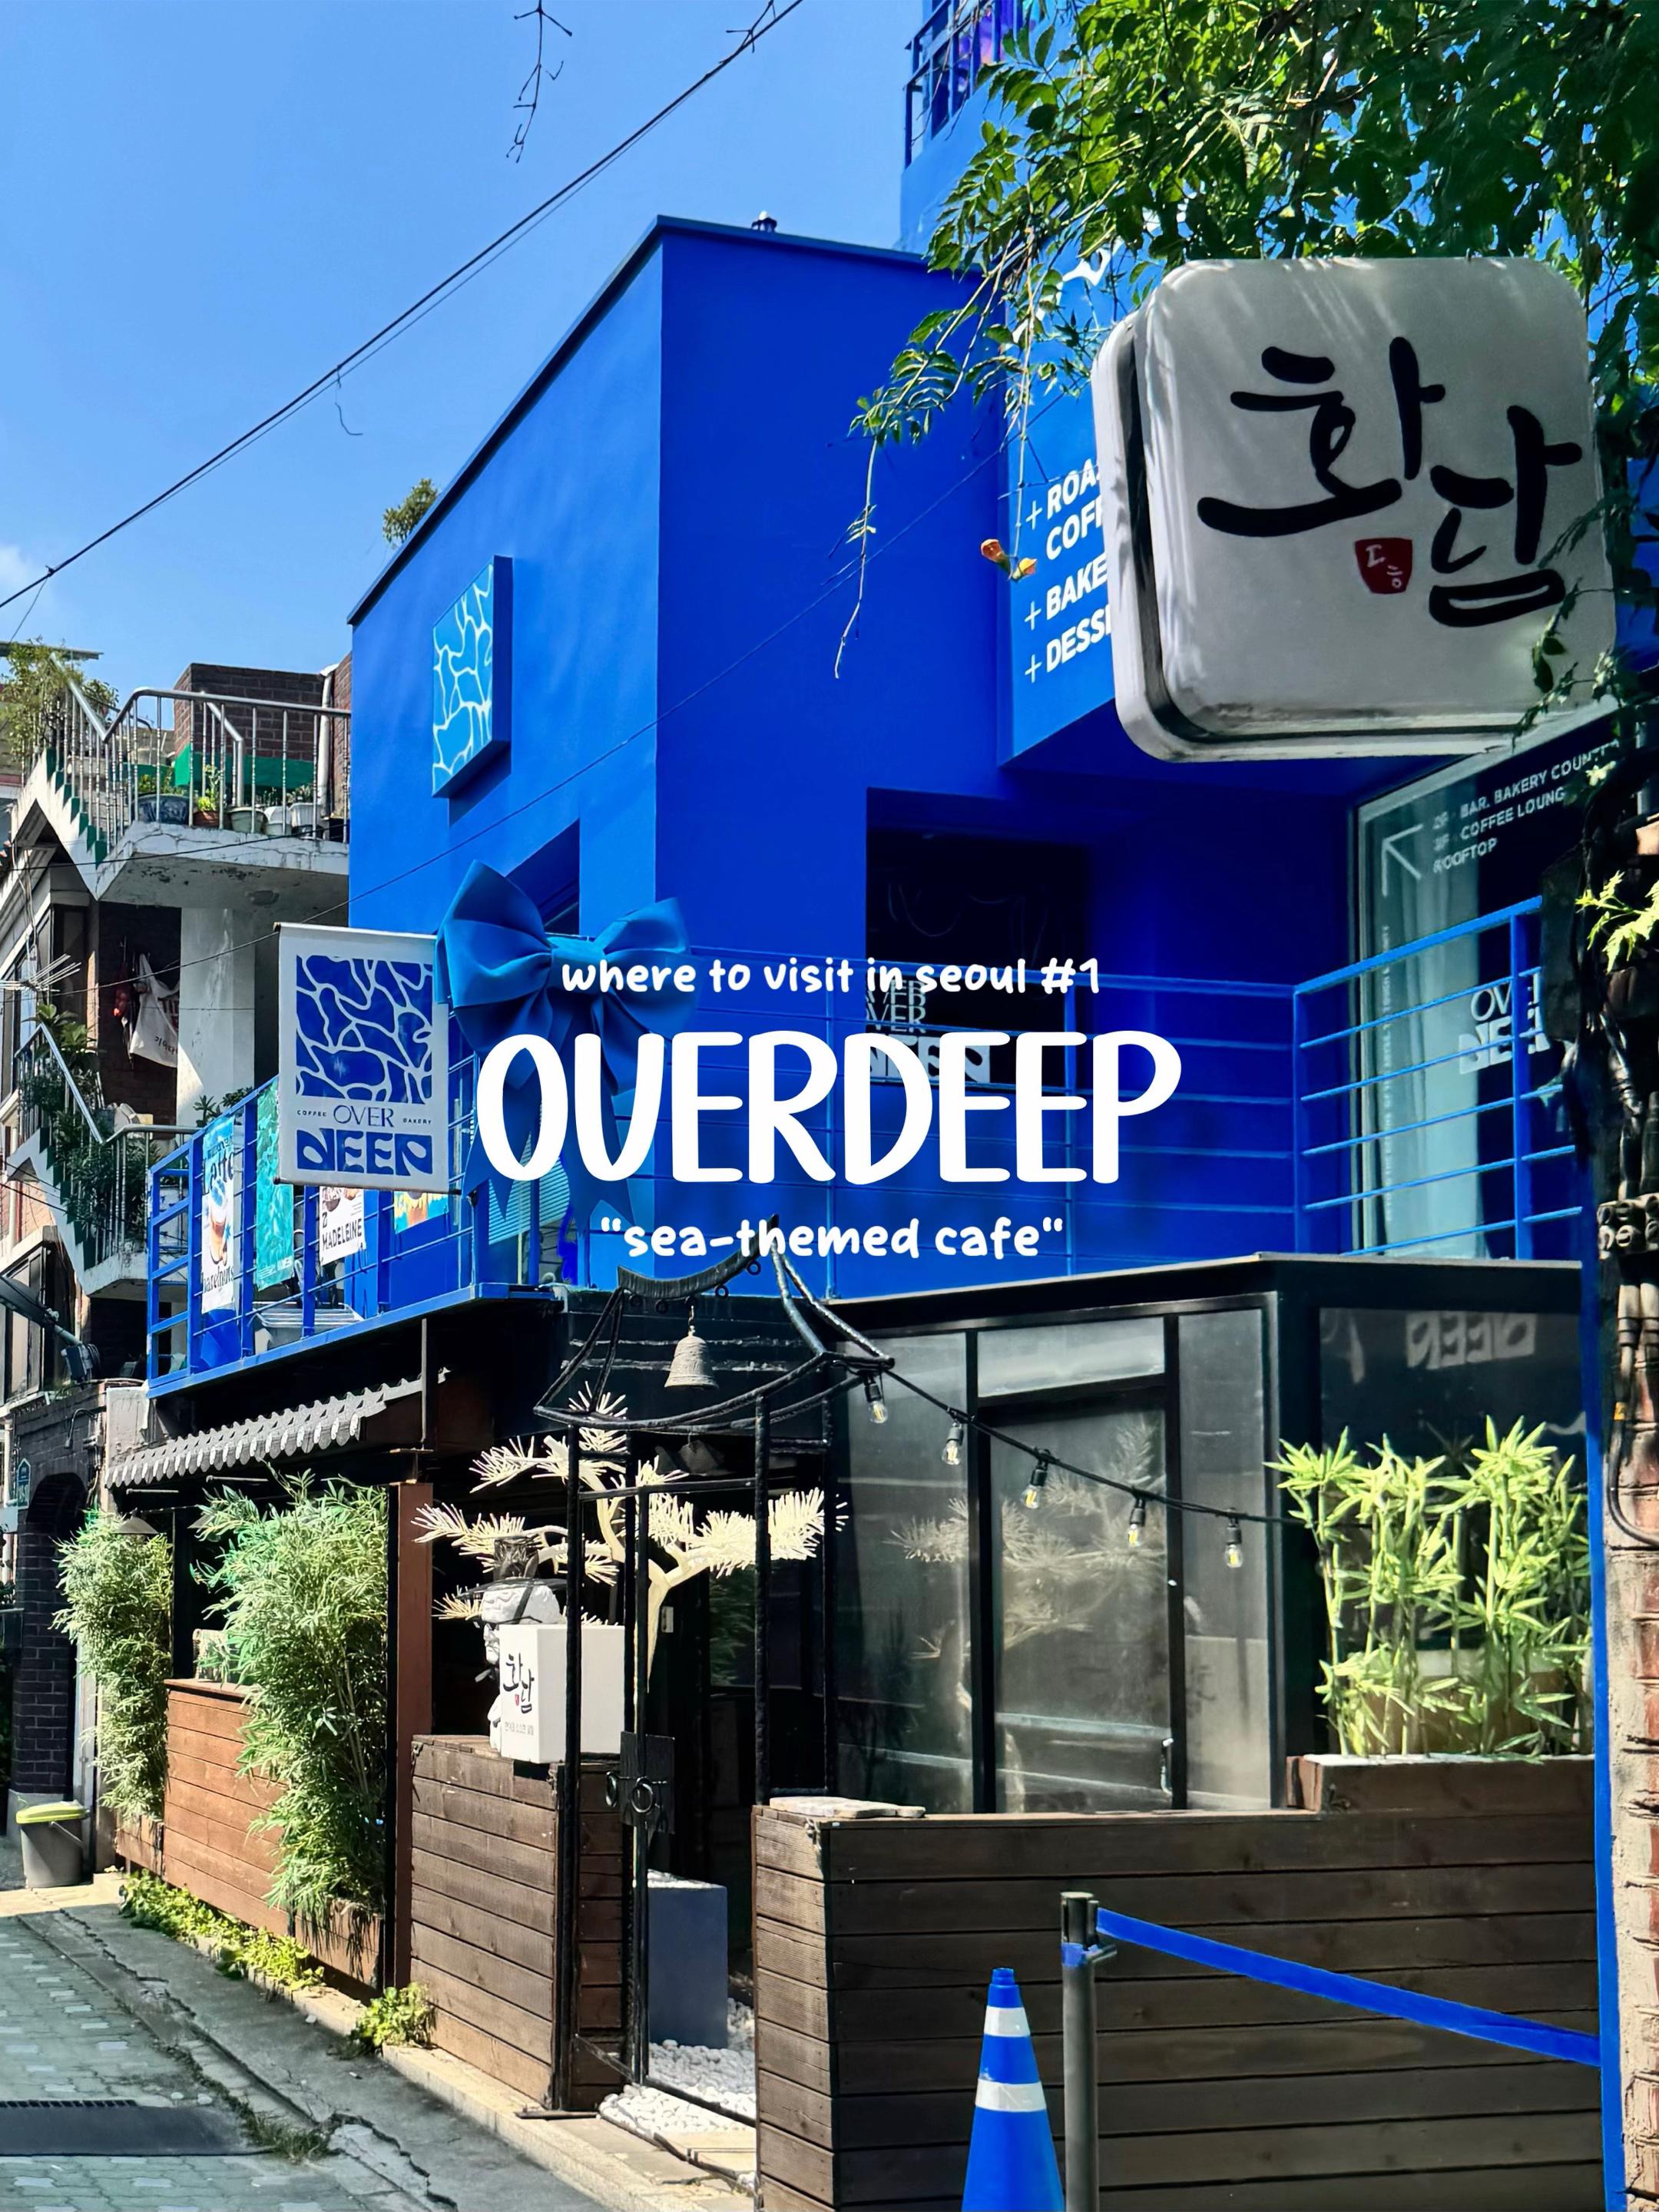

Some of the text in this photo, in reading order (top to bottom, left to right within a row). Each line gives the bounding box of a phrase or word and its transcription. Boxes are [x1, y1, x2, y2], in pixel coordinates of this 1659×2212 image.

[1048, 459, 1101, 520] ROA
[1494, 770, 1547, 804] BAKERY
[1460, 810, 1514, 840] COFFEE
[1517, 786, 1568, 819] LOUNG
[1432, 837, 1498, 874] ROOFTOP
[333, 1104, 394, 1128] OVER
[322, 1218, 362, 1252] MADELEINE
